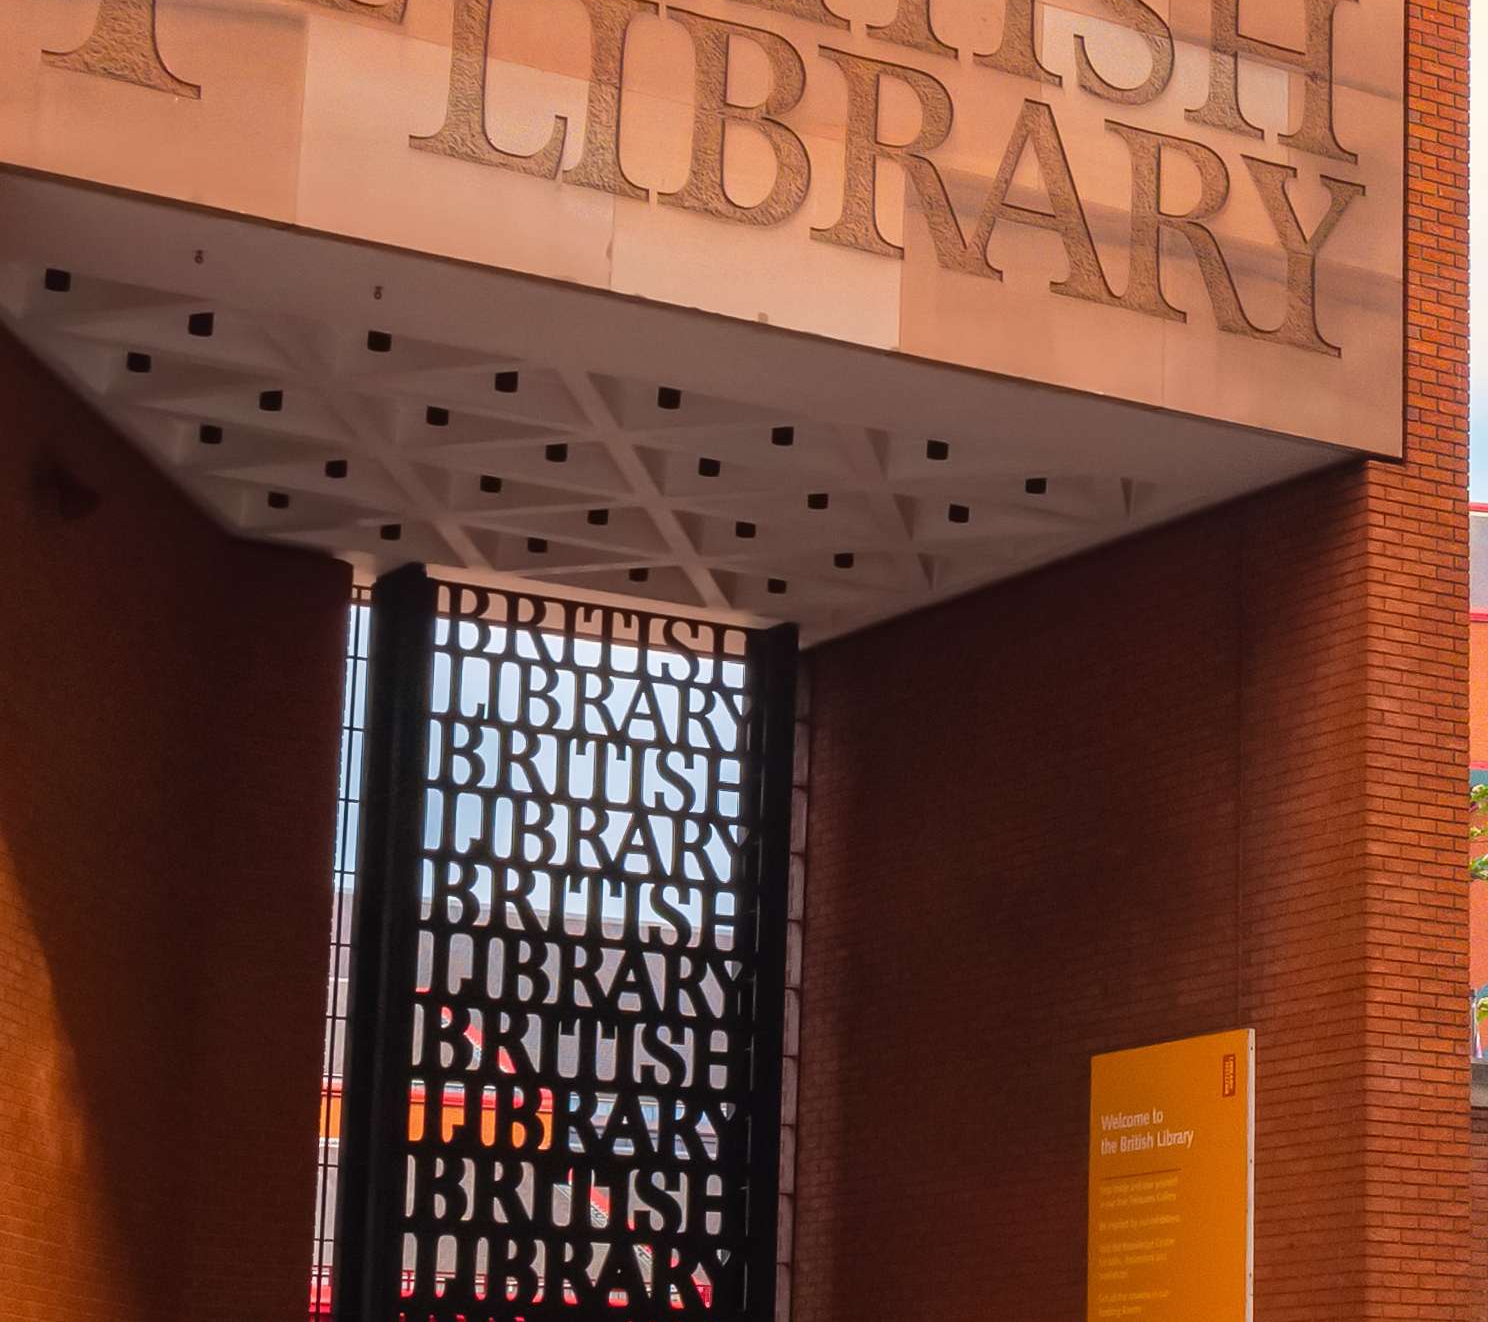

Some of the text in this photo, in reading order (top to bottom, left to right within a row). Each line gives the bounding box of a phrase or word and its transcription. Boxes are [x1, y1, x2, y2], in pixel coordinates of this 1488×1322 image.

[437, 580, 757, 689] BRITISH
[430, 649, 758, 753] LIBRARY
[427, 717, 752, 819] BRITISH
[423, 785, 752, 884] LIBRARY
[419, 855, 746, 953] BRITISH
[415, 927, 748, 1021] LIBRARY
[413, 1003, 739, 1091] BRITISH
[409, 1077, 740, 1162] LIBRARY
[1101, 1107, 1164, 1131] Welcome to
[1101, 1129, 1194, 1156] the British Library
